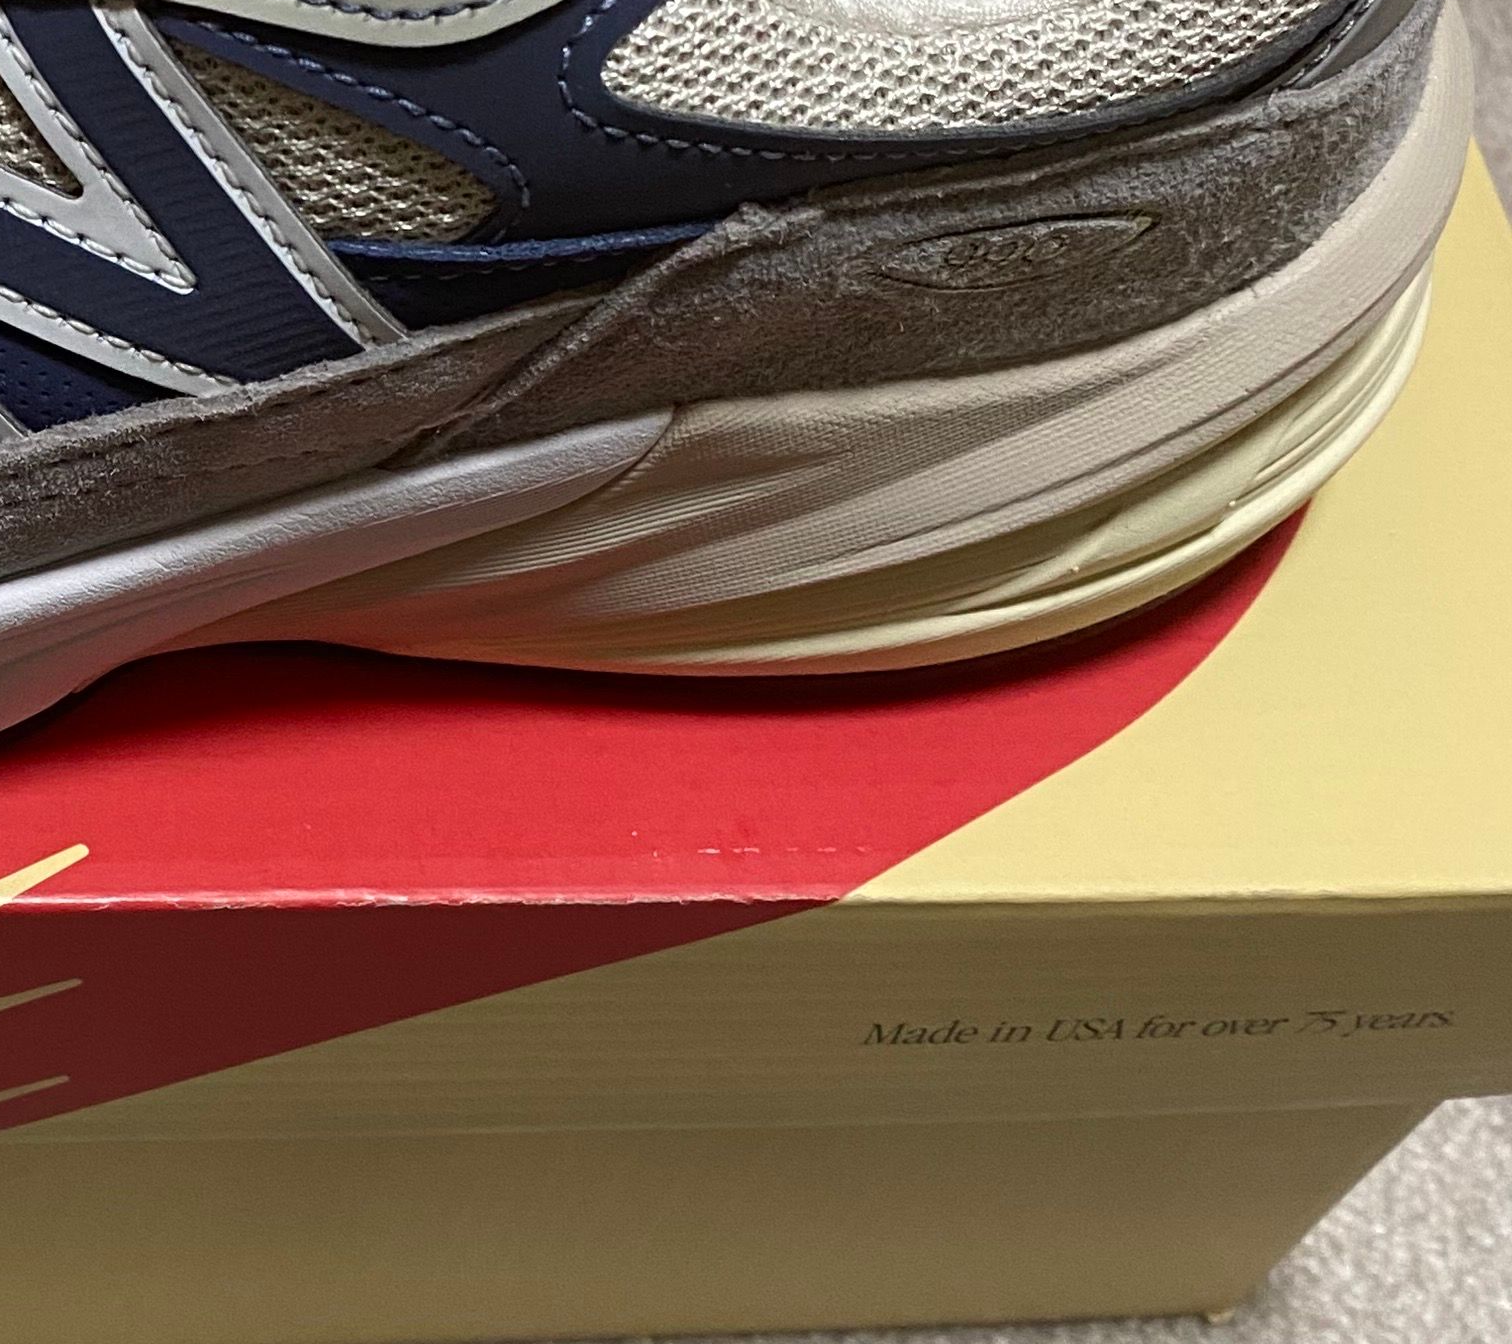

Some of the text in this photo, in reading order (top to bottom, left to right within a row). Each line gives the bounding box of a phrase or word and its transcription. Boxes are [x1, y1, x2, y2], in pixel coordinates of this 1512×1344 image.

[862, 1019, 979, 1046] Made
[989, 1020, 1034, 1044] in
[1045, 1017, 1126, 1043] USA
[1134, 1014, 1197, 1040] for
[1201, 1017, 1291, 1037] over
[1339, 1010, 1455, 1038] years
